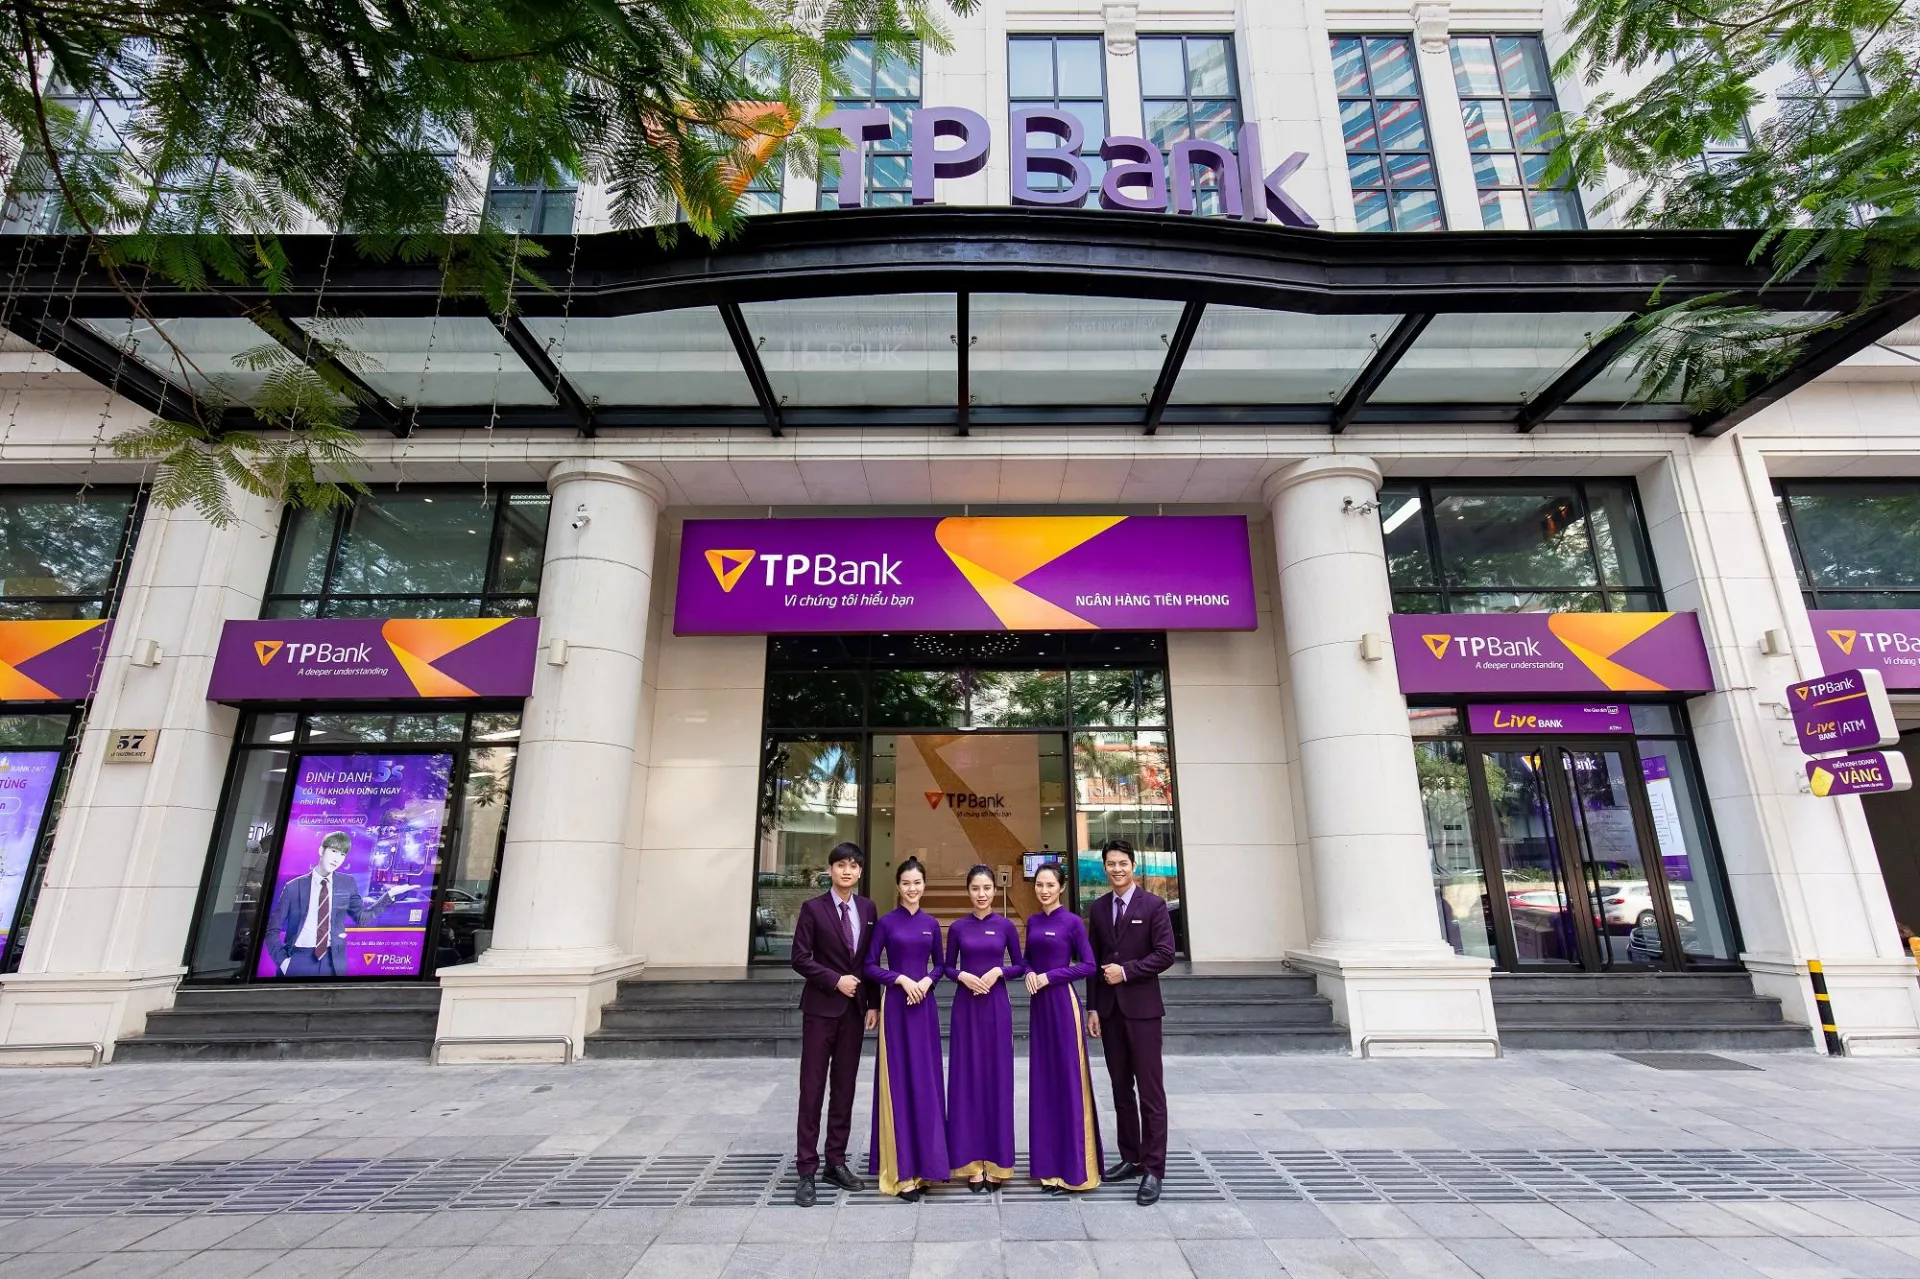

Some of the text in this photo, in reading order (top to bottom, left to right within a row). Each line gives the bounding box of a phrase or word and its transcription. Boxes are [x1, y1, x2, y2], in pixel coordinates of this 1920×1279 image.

[819, 107, 1320, 229] TPBank
[760, 553, 903, 586] TPBank
[784, 591, 914, 609] Vì chúng tôi hiểu bạn
[1075, 592, 1230, 606] NGÂN HÀNG TIÊN PHONG
[286, 642, 372, 664] TPBank
[1454, 636, 1542, 657] TPBank
[1475, 661, 1564, 670] A deeper understanding
[1893, 657, 1916, 667] chúng
[297, 667, 389, 677] A deeper understanding
[1810, 677, 1855, 697] TPBank
[1493, 710, 1563, 728] Live BANK
[1842, 719, 1866, 734] ATM
[1806, 721, 1836, 736] Live
[1818, 731, 1838, 741] BANK
[117, 735, 146, 749] 57
[306, 771, 336, 785] ĐỊNH
[338, 771, 373, 783] DANH
[1838, 767, 1883, 785] VÀNG
[380, 787, 402, 796] NGAY
[946, 793, 1005, 808] TPBank
[376, 954, 412, 965] TPBank
